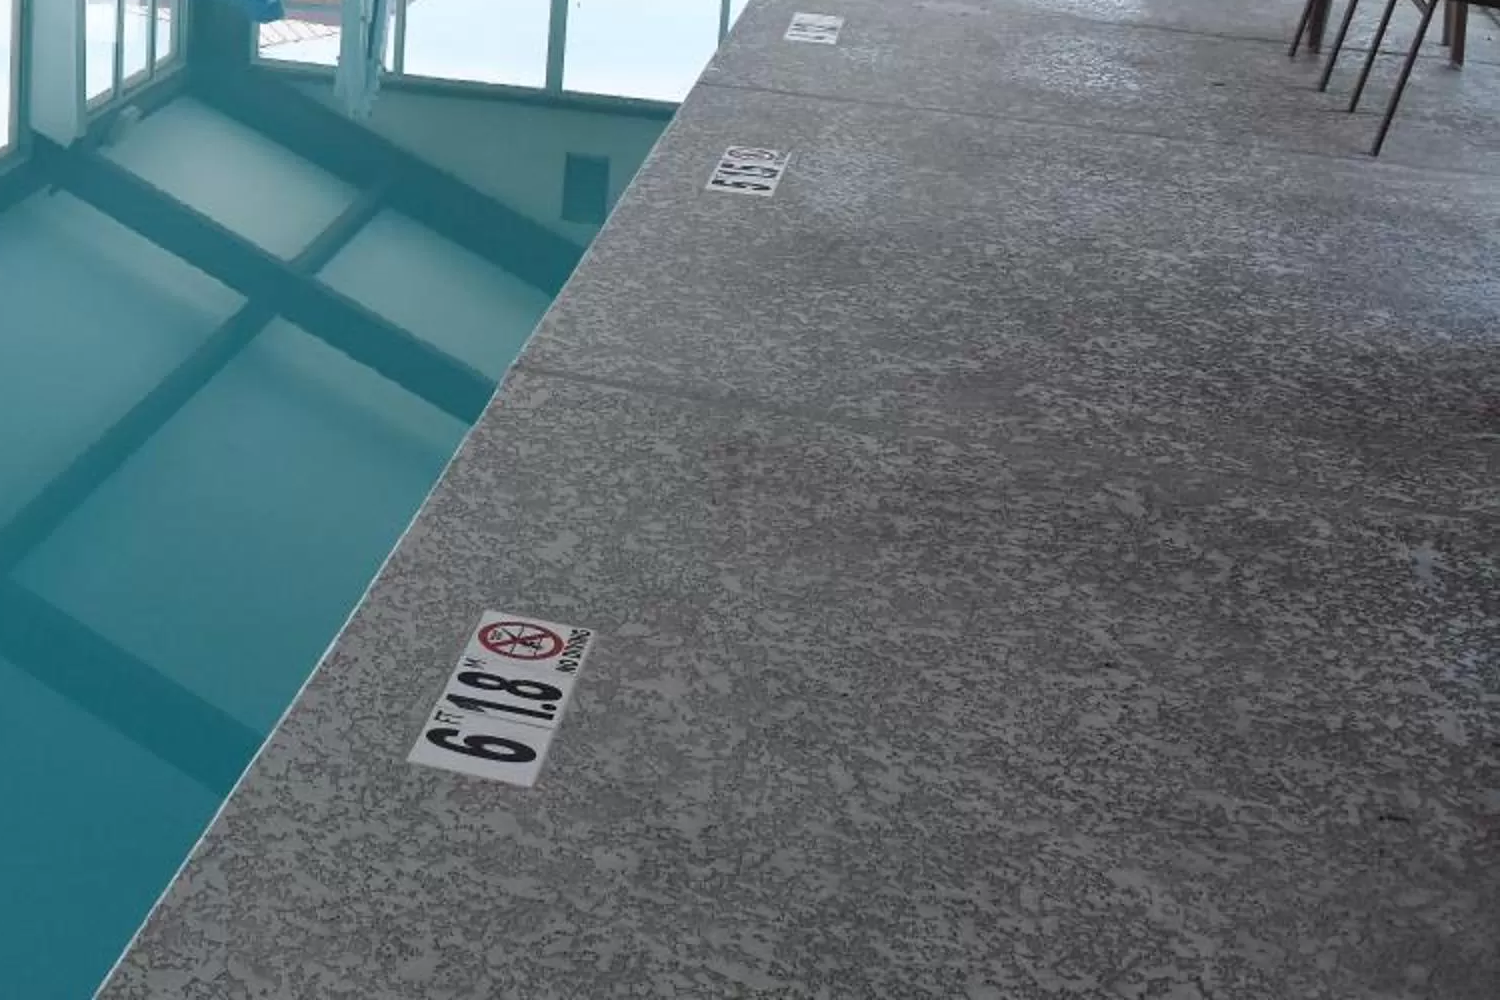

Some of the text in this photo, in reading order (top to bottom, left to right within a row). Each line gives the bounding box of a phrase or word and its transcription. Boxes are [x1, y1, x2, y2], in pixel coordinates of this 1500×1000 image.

[446, 671, 562, 720] 1.8
[434, 710, 464, 724] FT
[426, 728, 536, 762] 6
